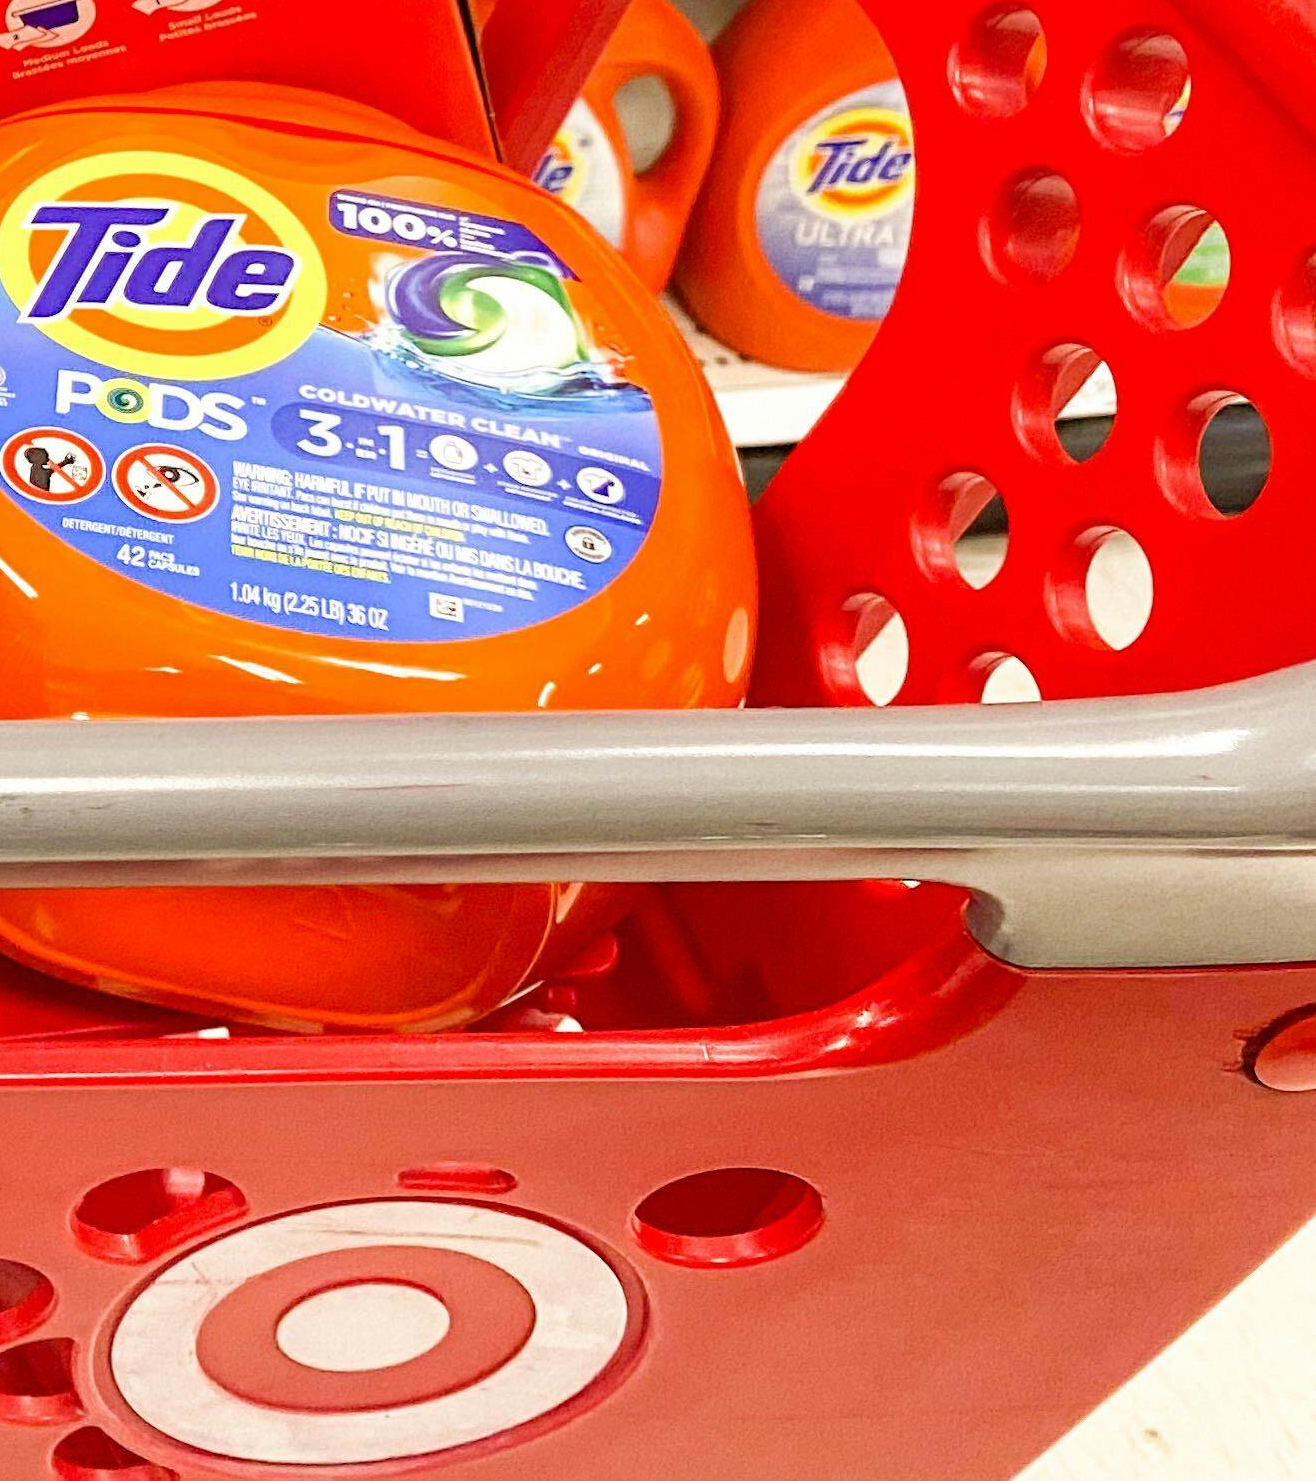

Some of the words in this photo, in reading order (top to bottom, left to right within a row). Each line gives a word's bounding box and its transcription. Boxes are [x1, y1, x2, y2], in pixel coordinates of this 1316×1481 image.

[808, 140, 912, 194] Tide
[337, 202, 458, 248] 100%
[794, 221, 894, 247] ULTRA
[20, 202, 297, 323] Tide
[55, 369, 248, 440] PODS
[298, 385, 466, 428] COLDWATER
[470, 417, 561, 448] CLEAN
[117, 544, 146, 567] 42
[148, 559, 200, 576] CAPSULES
[230, 581, 261, 605] 1.04
[263, 587, 281, 613] kg
[284, 591, 318, 616] (2.25
[321, 598, 345, 625] LB)
[347, 605, 366, 625] 36
[368, 607, 389, 631] OZ
